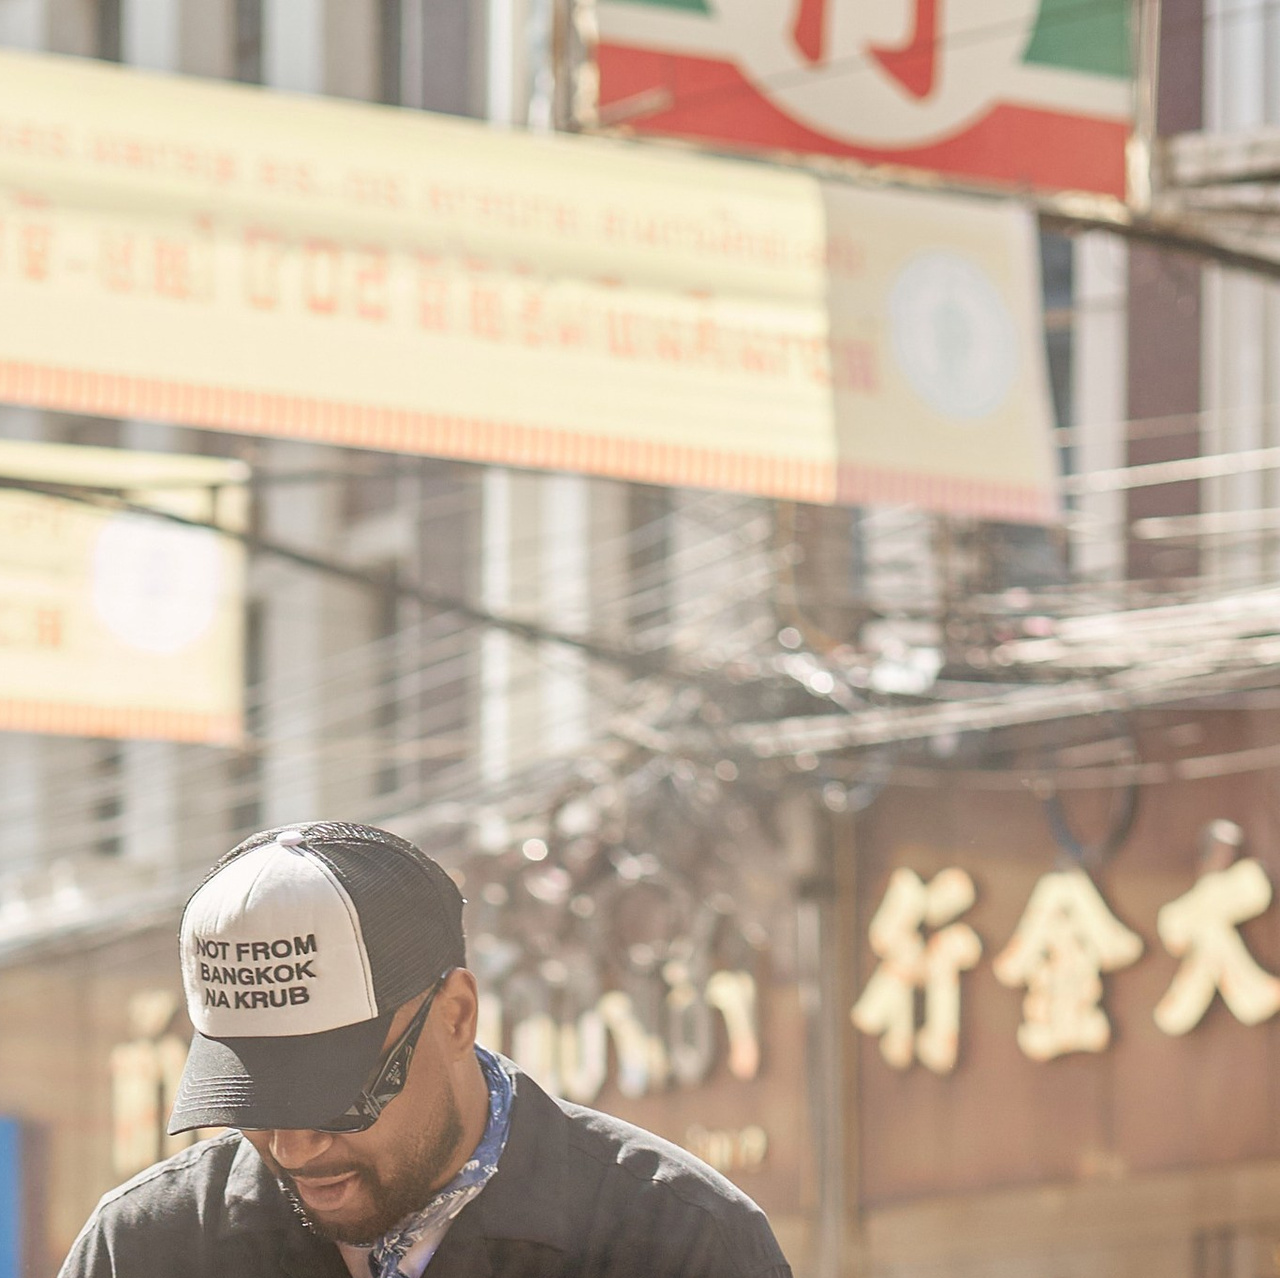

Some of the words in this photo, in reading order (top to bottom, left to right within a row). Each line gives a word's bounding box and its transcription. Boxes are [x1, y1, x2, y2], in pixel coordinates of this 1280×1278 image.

[196, 937, 230, 960] NOT
[236, 934, 317, 962] FROM
[201, 960, 316, 986] BANGKOK
[205, 988, 231, 1008] NA
[234, 986, 310, 1009] KRUB
